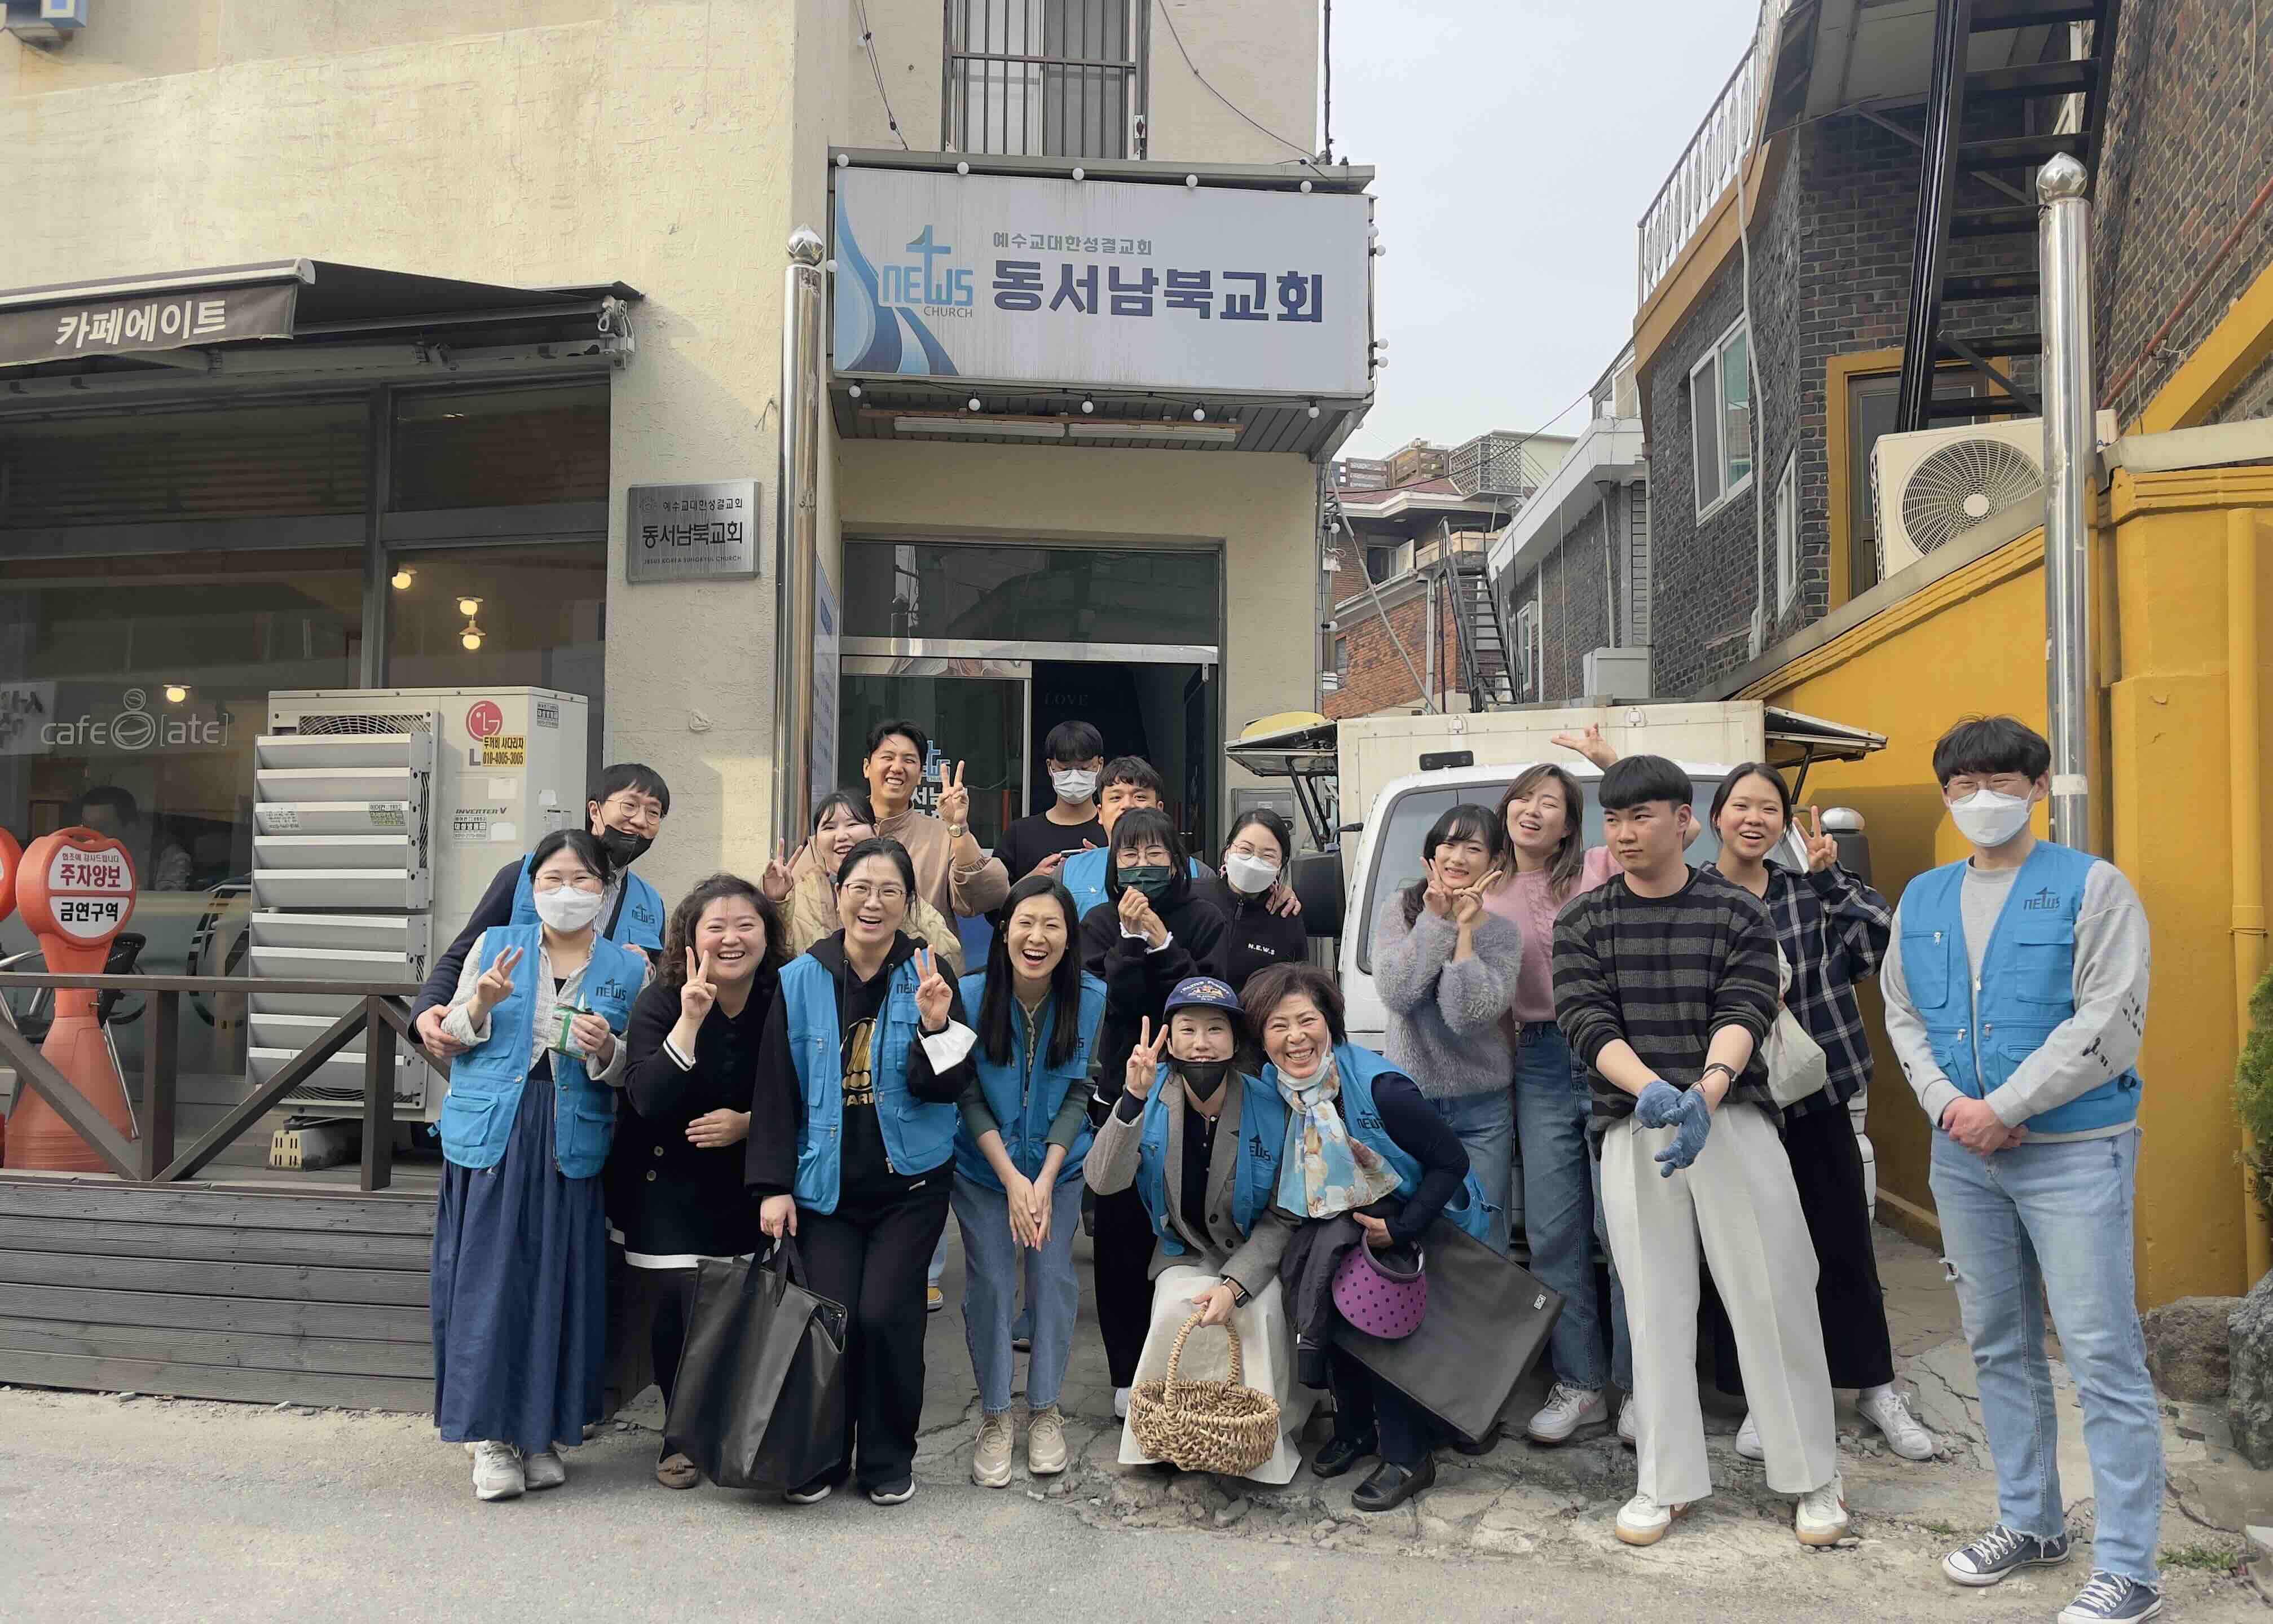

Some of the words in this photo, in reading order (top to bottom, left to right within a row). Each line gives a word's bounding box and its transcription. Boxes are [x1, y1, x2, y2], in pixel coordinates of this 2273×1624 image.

[993, 232, 1152, 256] 예수교대한성결교회
[992, 259, 1323, 323] 동서남북교회
[55, 300, 226, 349] 카페에이트
[923, 306, 973, 318] CHURCH
[663, 498, 743, 513] 예수교대한성결교회
[642, 520, 743, 549] 동서남북교회
[41, 714, 107, 745] cafe
[60, 863, 121, 888] 주차양보
[60, 902, 119, 922] 금연구역
